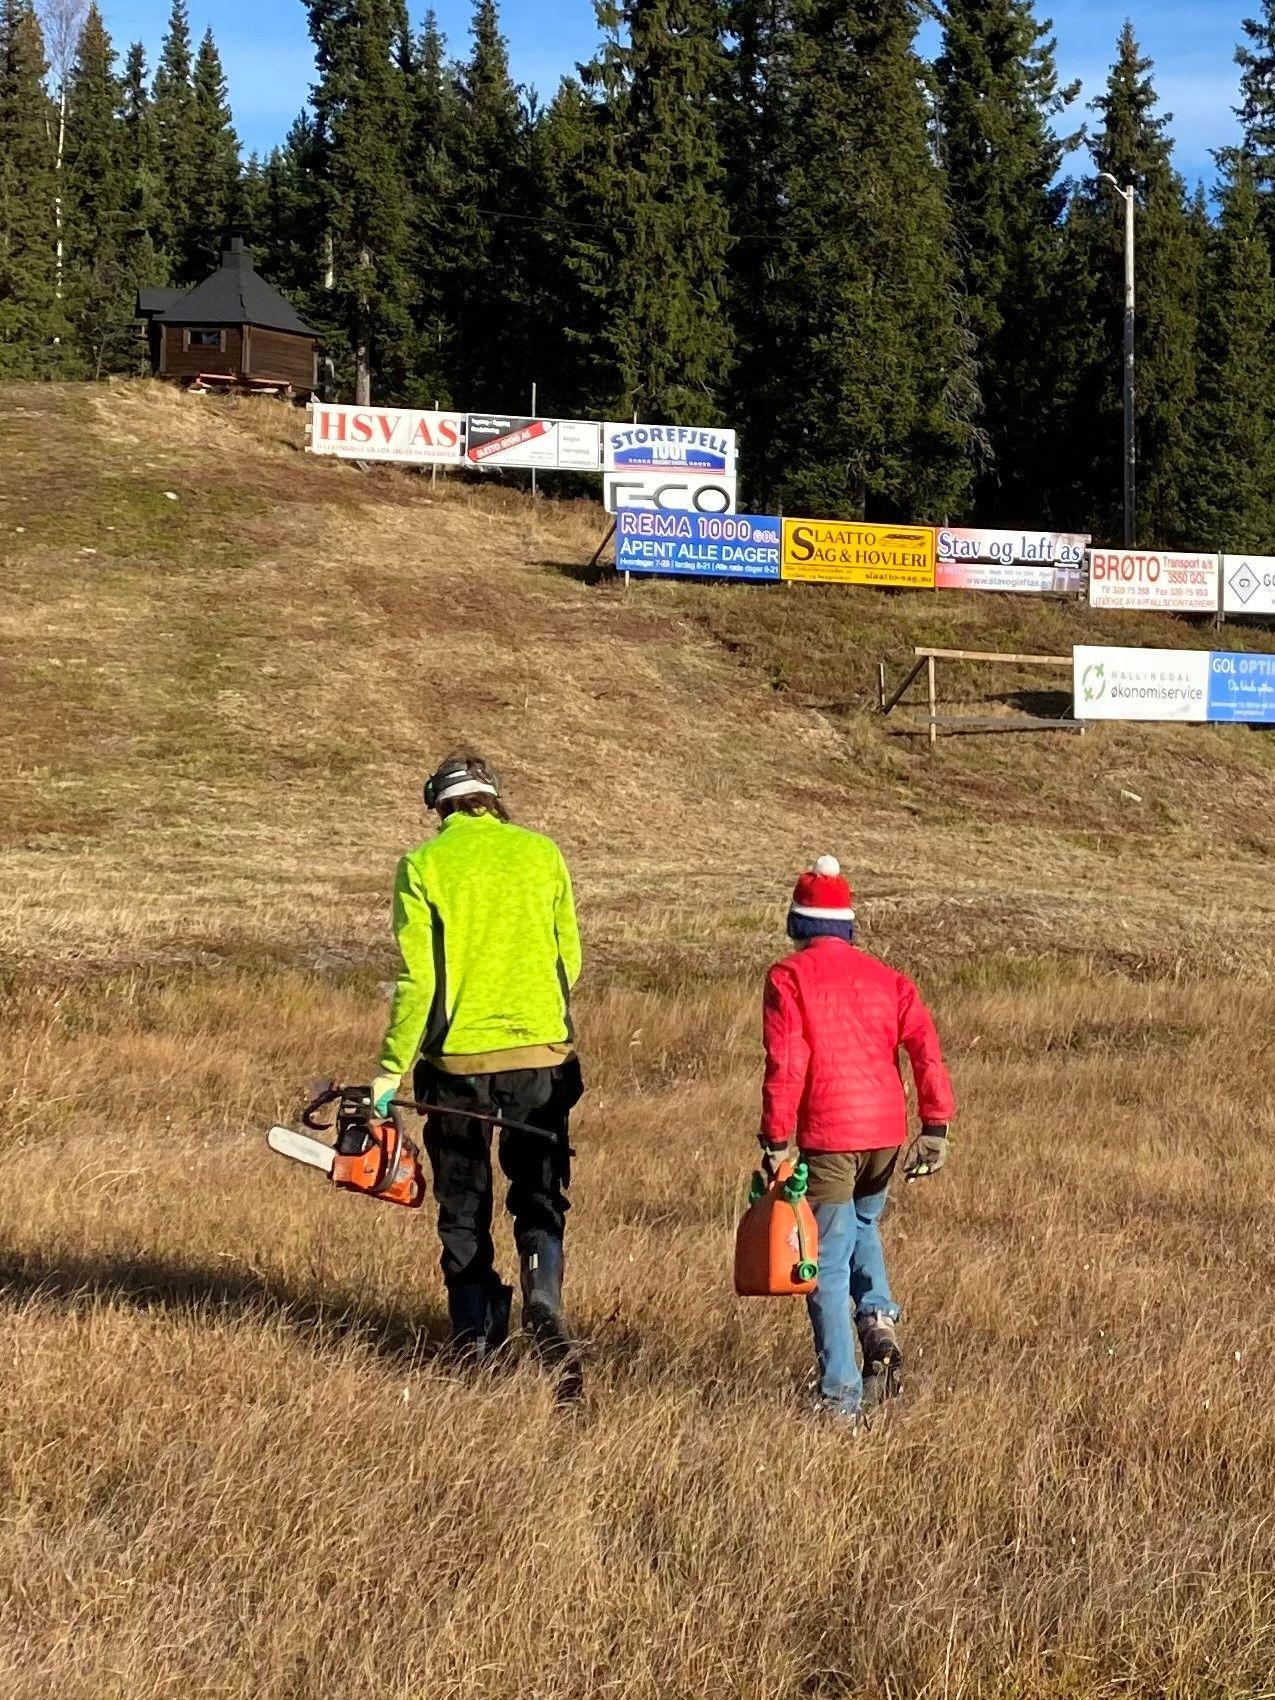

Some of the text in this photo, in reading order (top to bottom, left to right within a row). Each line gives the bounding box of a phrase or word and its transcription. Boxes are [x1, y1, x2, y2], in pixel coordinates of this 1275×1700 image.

[320, 411, 402, 444] HSV
[409, 417, 458, 447] AS
[610, 428, 728, 455] STOREFJELL
[621, 512, 779, 544] REMA 1000 GOL
[619, 537, 779, 563] ÅPENT ALLE DAGER
[840, 550, 851, 563] &
[856, 550, 926, 567] HØVLERI
[939, 532, 1080, 565] Stav og laft as
[1093, 554, 1160, 581] BRØTO
[1163, 556, 1200, 569] Transport
[1189, 571, 1208, 585] GOL
[1212, 657, 1237, 673] GOL
[1111, 671, 1191, 682] HALLINGDAL
[1111, 684, 1202, 700] økonomiservice
